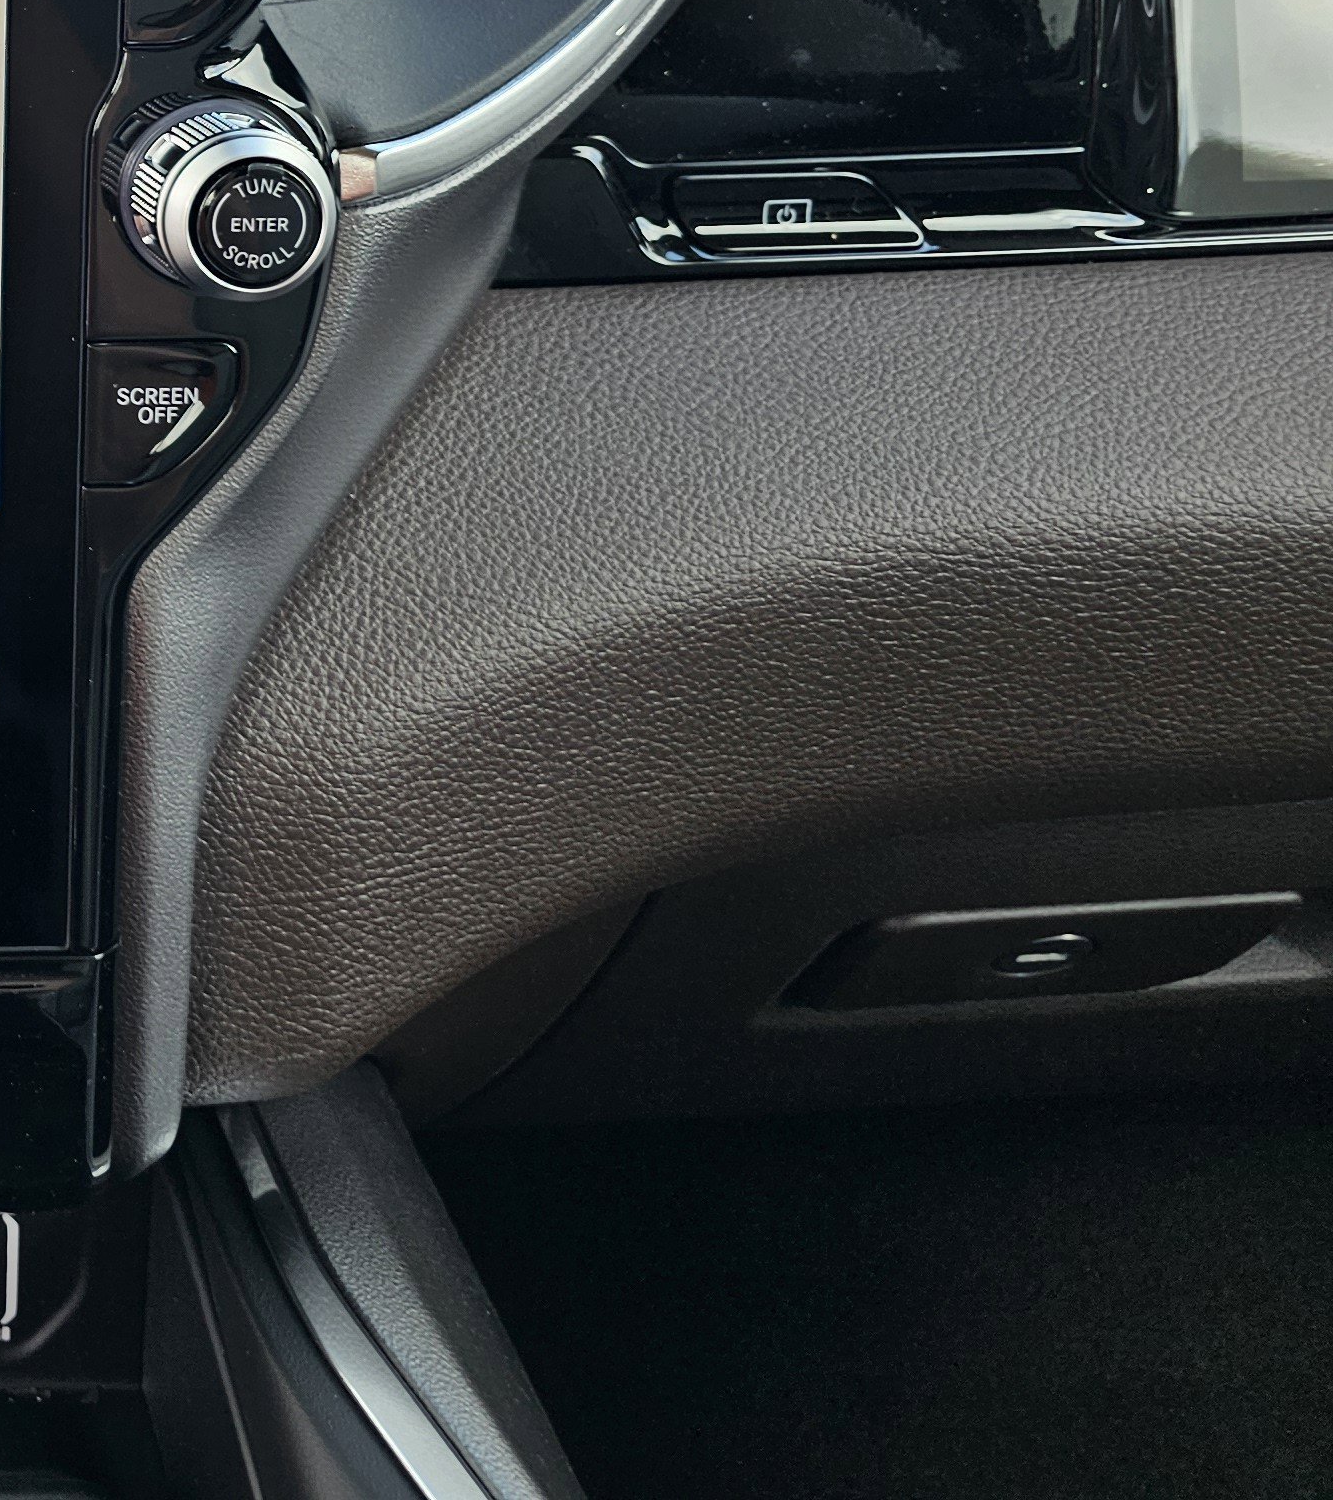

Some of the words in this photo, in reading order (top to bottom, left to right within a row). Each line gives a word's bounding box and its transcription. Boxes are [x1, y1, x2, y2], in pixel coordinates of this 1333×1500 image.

[232, 177, 288, 199] TUNE
[230, 217, 289, 234] ENTER
[222, 245, 296, 270] SCROLL
[117, 387, 199, 405] SCREEN
[138, 407, 179, 424] OFF
